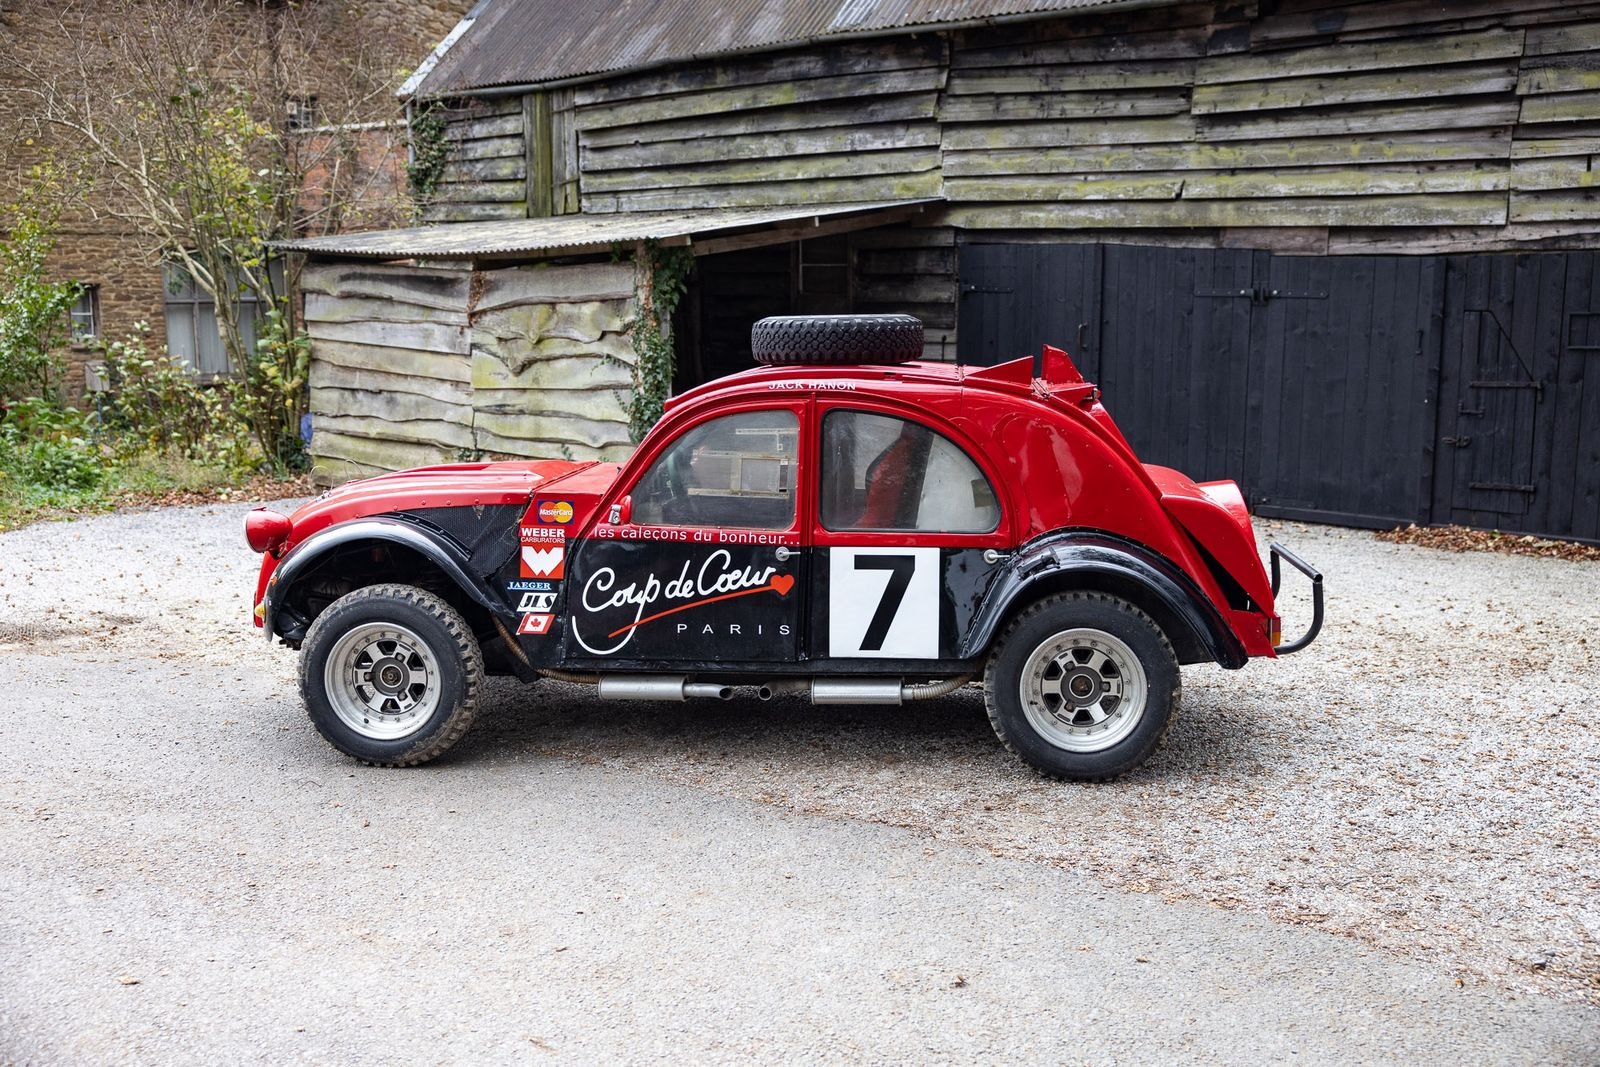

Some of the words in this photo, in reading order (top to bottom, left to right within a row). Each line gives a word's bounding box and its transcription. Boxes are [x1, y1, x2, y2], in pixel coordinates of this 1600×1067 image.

[768, 381, 804, 390] JACK
[808, 381, 856, 391] HANON
[539, 508, 573, 517] MasterCard
[521, 527, 565, 538] WEBER
[594, 528, 615, 538] les
[621, 528, 687, 542] caleçons
[693, 529, 713, 542] du
[719, 530, 801, 546] bonheur...
[665, 559, 695, 599] de
[507, 581, 551, 591] JAEGER
[854, 554, 916, 651] 7
[676, 623, 791, 636] PARIS
